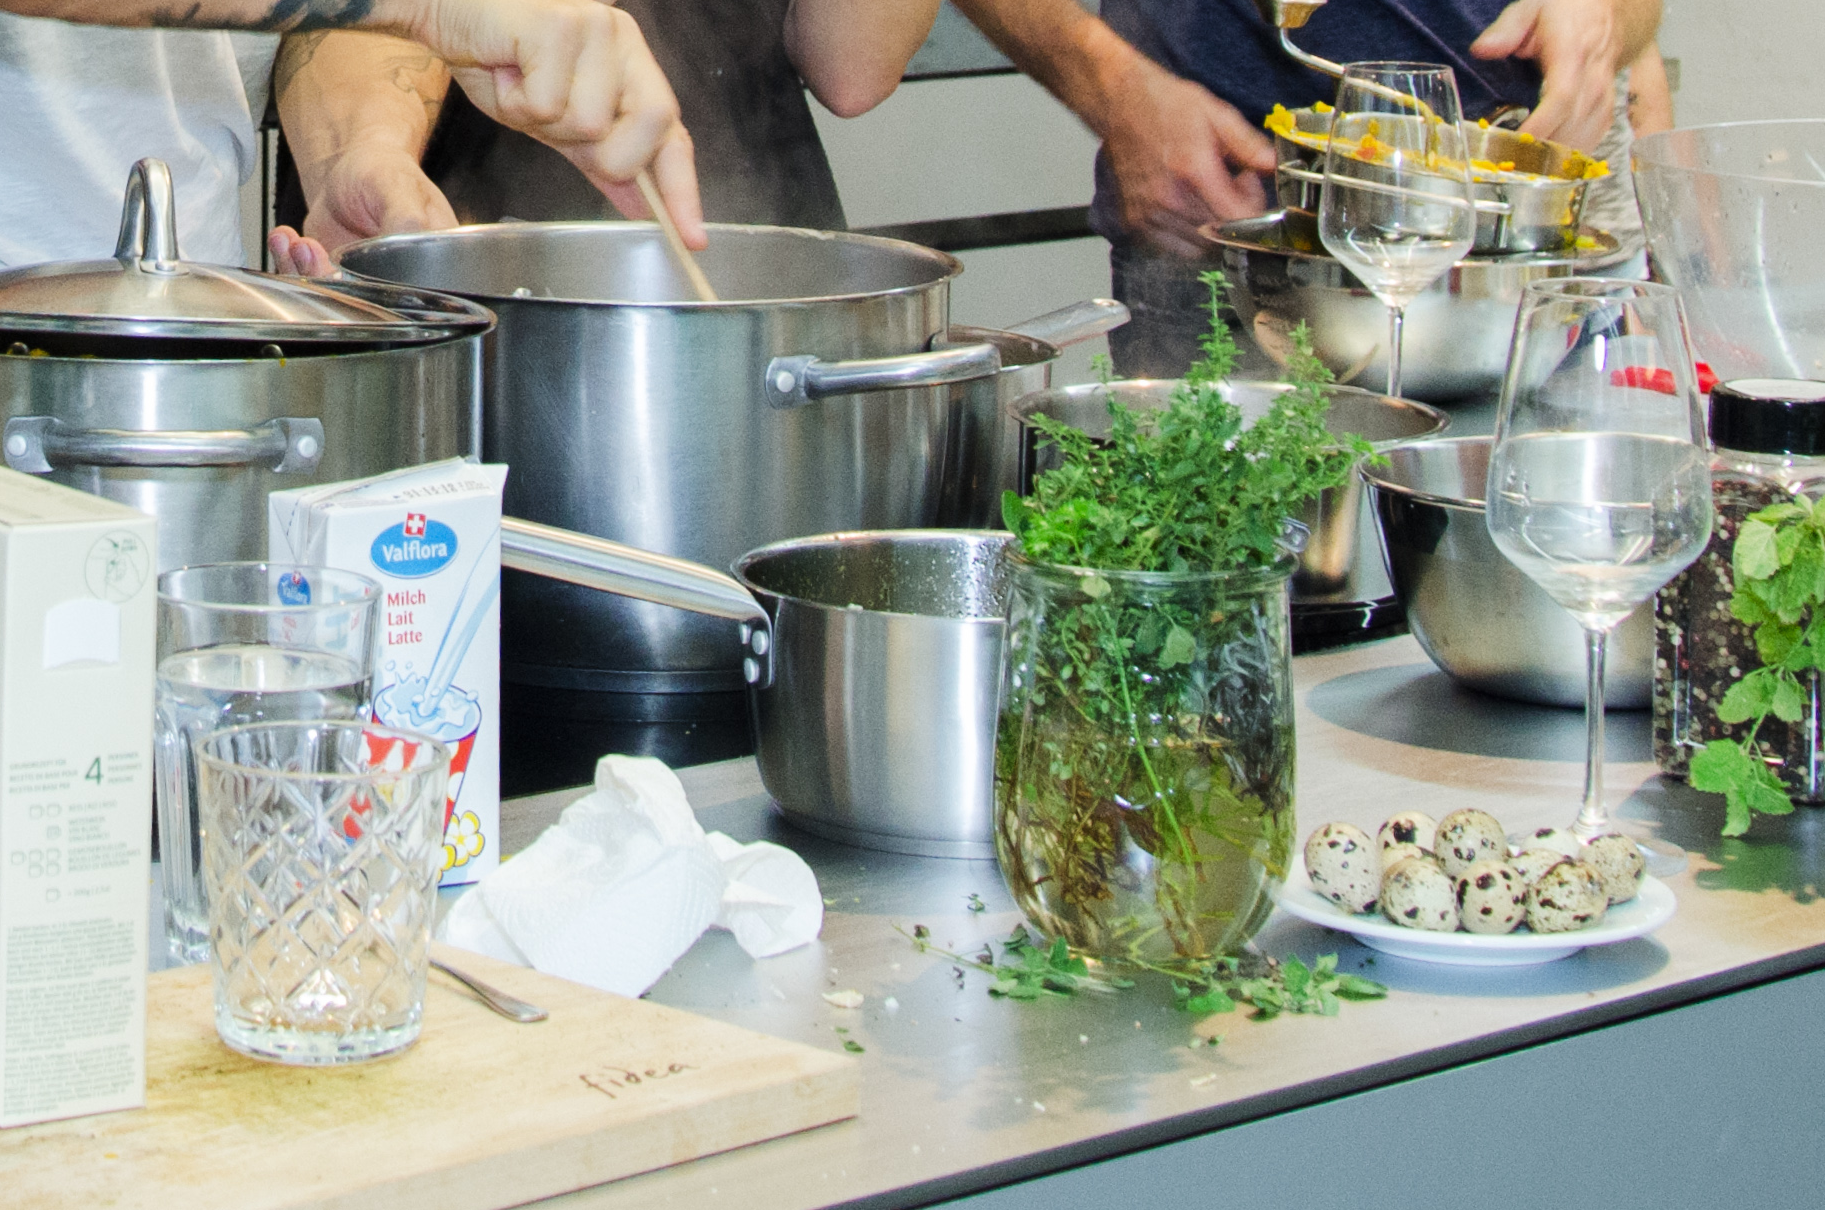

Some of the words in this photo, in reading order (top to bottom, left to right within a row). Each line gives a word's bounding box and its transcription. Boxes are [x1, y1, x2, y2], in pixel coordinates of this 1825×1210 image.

[383, 540, 448, 563] Valflora
[387, 589, 426, 607] Milch
[387, 610, 414, 626] Lait
[388, 630, 423, 646] Latte
[84, 755, 104, 786] 4
